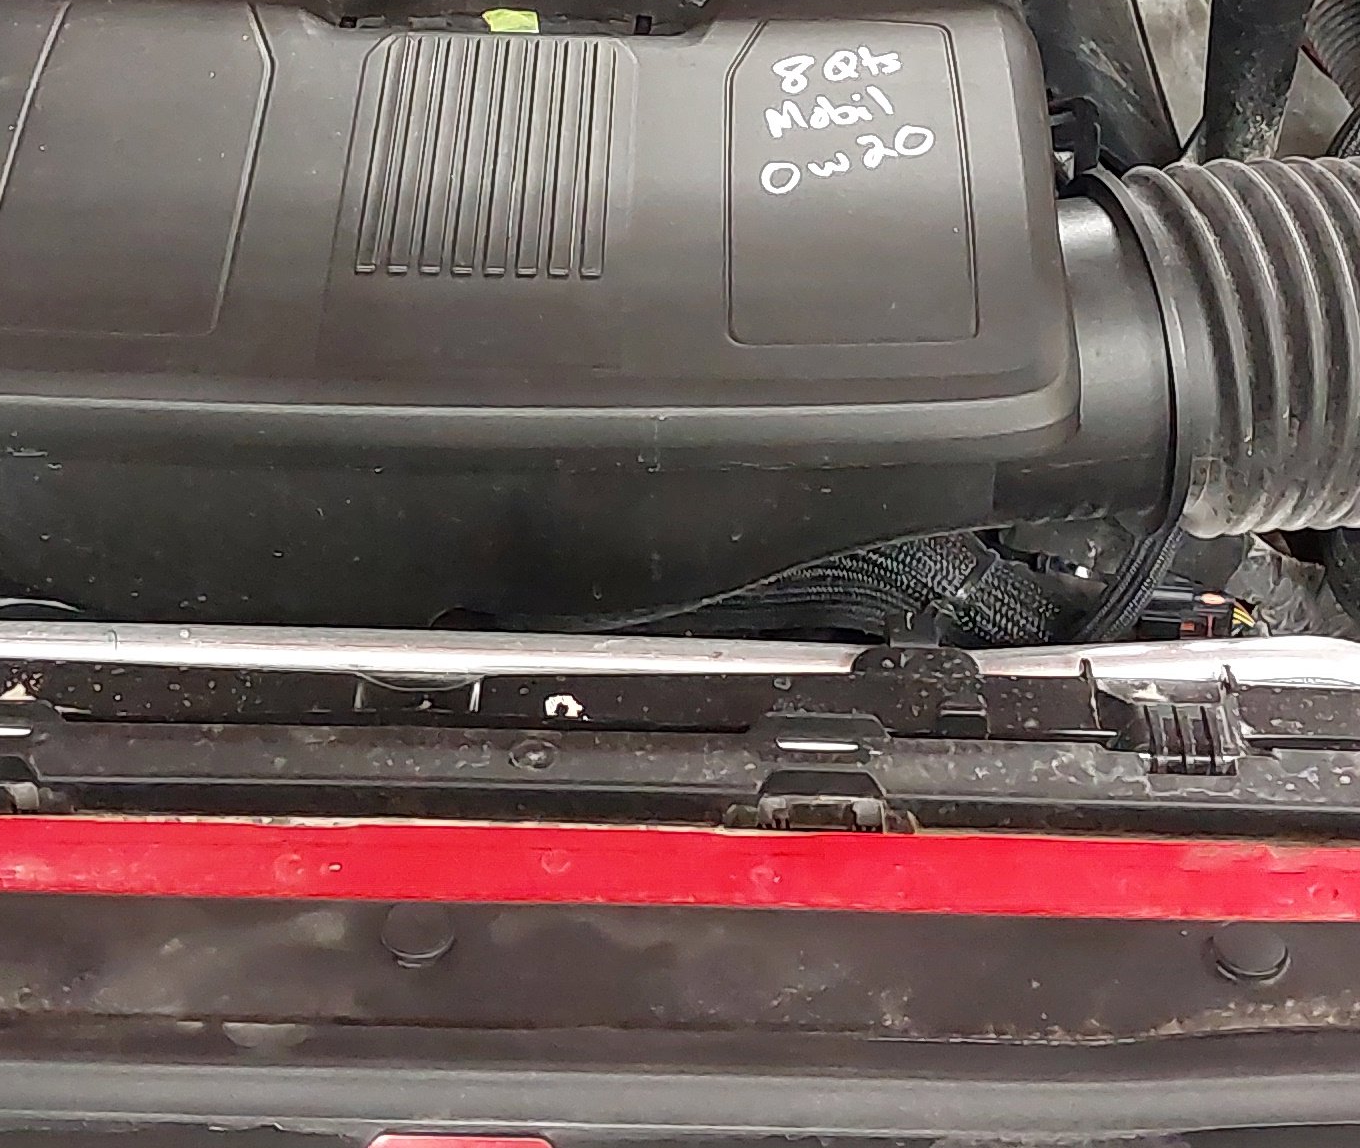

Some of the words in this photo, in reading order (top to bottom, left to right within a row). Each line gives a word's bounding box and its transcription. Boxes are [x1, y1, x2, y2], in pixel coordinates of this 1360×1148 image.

[771, 54, 815, 94] 8
[822, 44, 903, 82] Qts
[764, 85, 894, 138] Mobil
